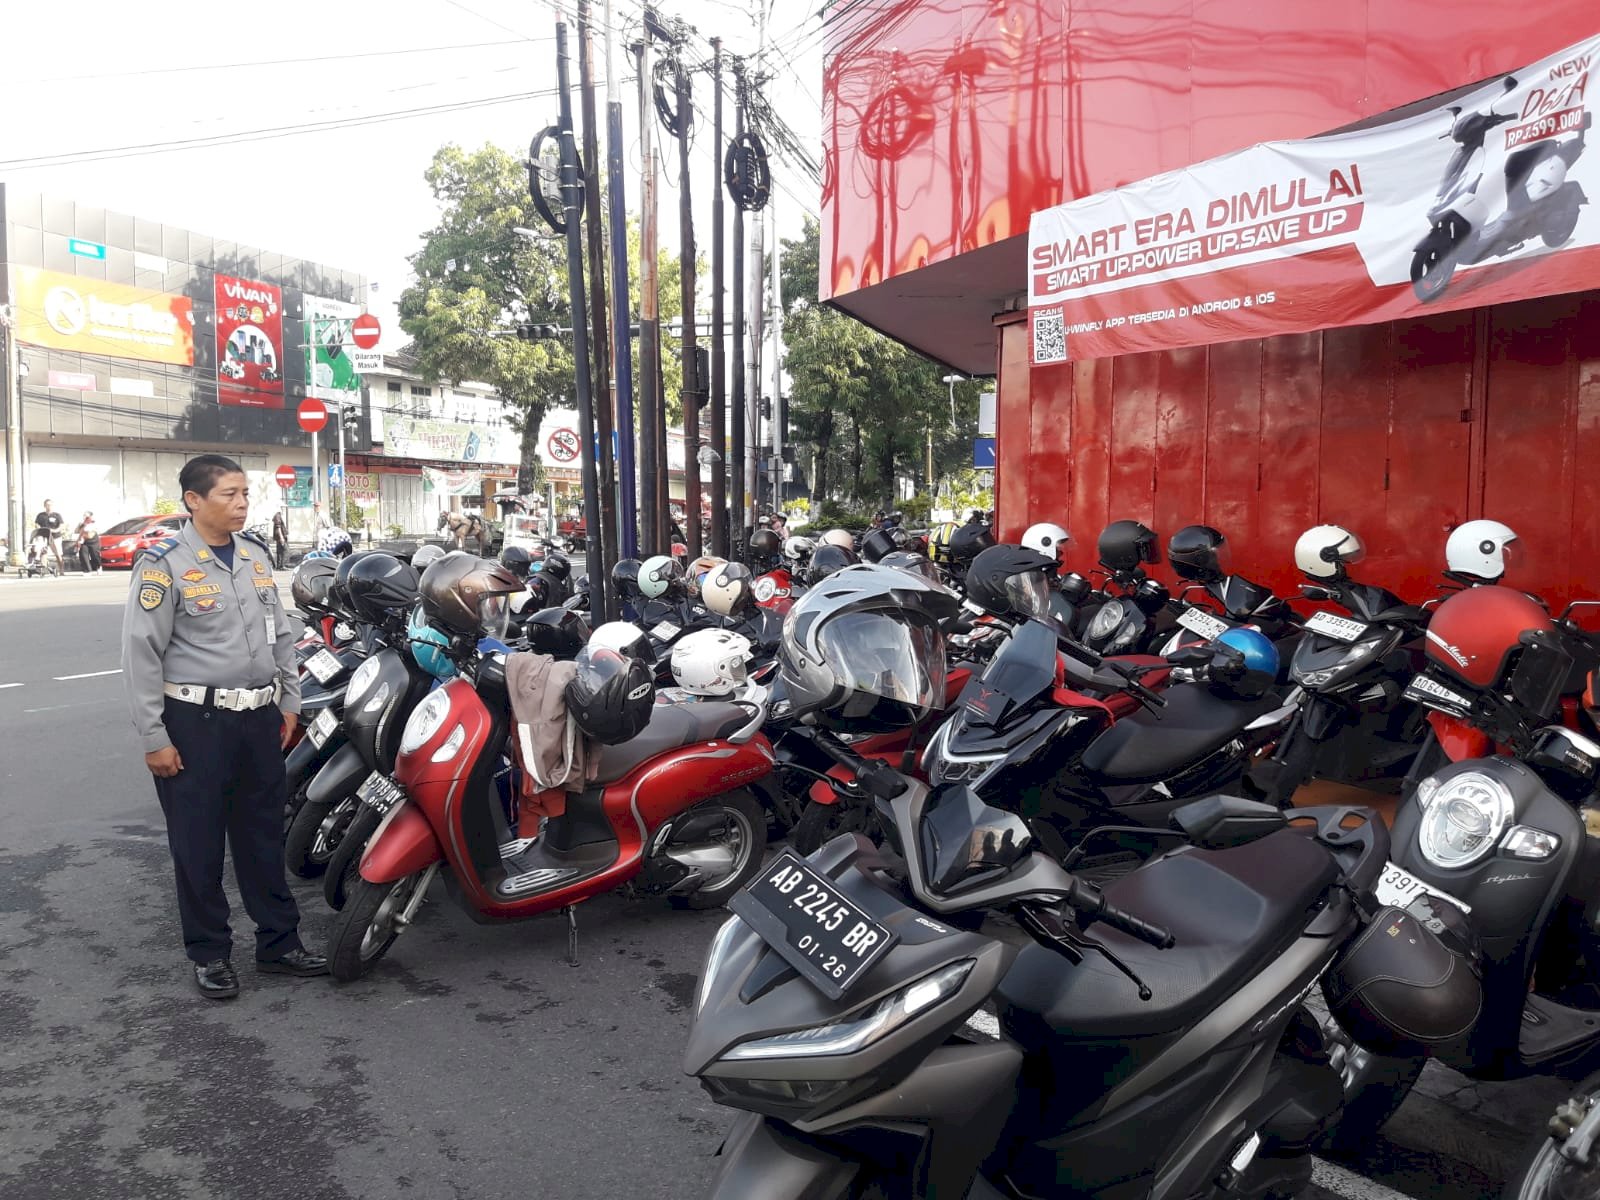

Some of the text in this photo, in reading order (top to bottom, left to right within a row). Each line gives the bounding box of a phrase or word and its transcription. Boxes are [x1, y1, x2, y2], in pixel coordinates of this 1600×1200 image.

[1549, 55, 1591, 81] NEW
[1033, 164, 1363, 271] SMART ERA DIMULAI
[1047, 263, 1102, 291] SMART
[1308, 209, 1347, 235] UP
[1033, 308, 1057, 317] SCAN
[1105, 317, 1125, 329] APP
[1127, 309, 1176, 325] TERSEDIA
[1179, 306, 1189, 317] DI
[1191, 298, 1241, 316] ANDROID
[1243, 296, 1253, 307] &
[354, 353, 381, 362] Dilarang
[357, 361, 379, 369] Masuk
[769, 865, 804, 894] AB
[793, 883, 850, 932] 2245
[841, 921, 879, 958] BR
